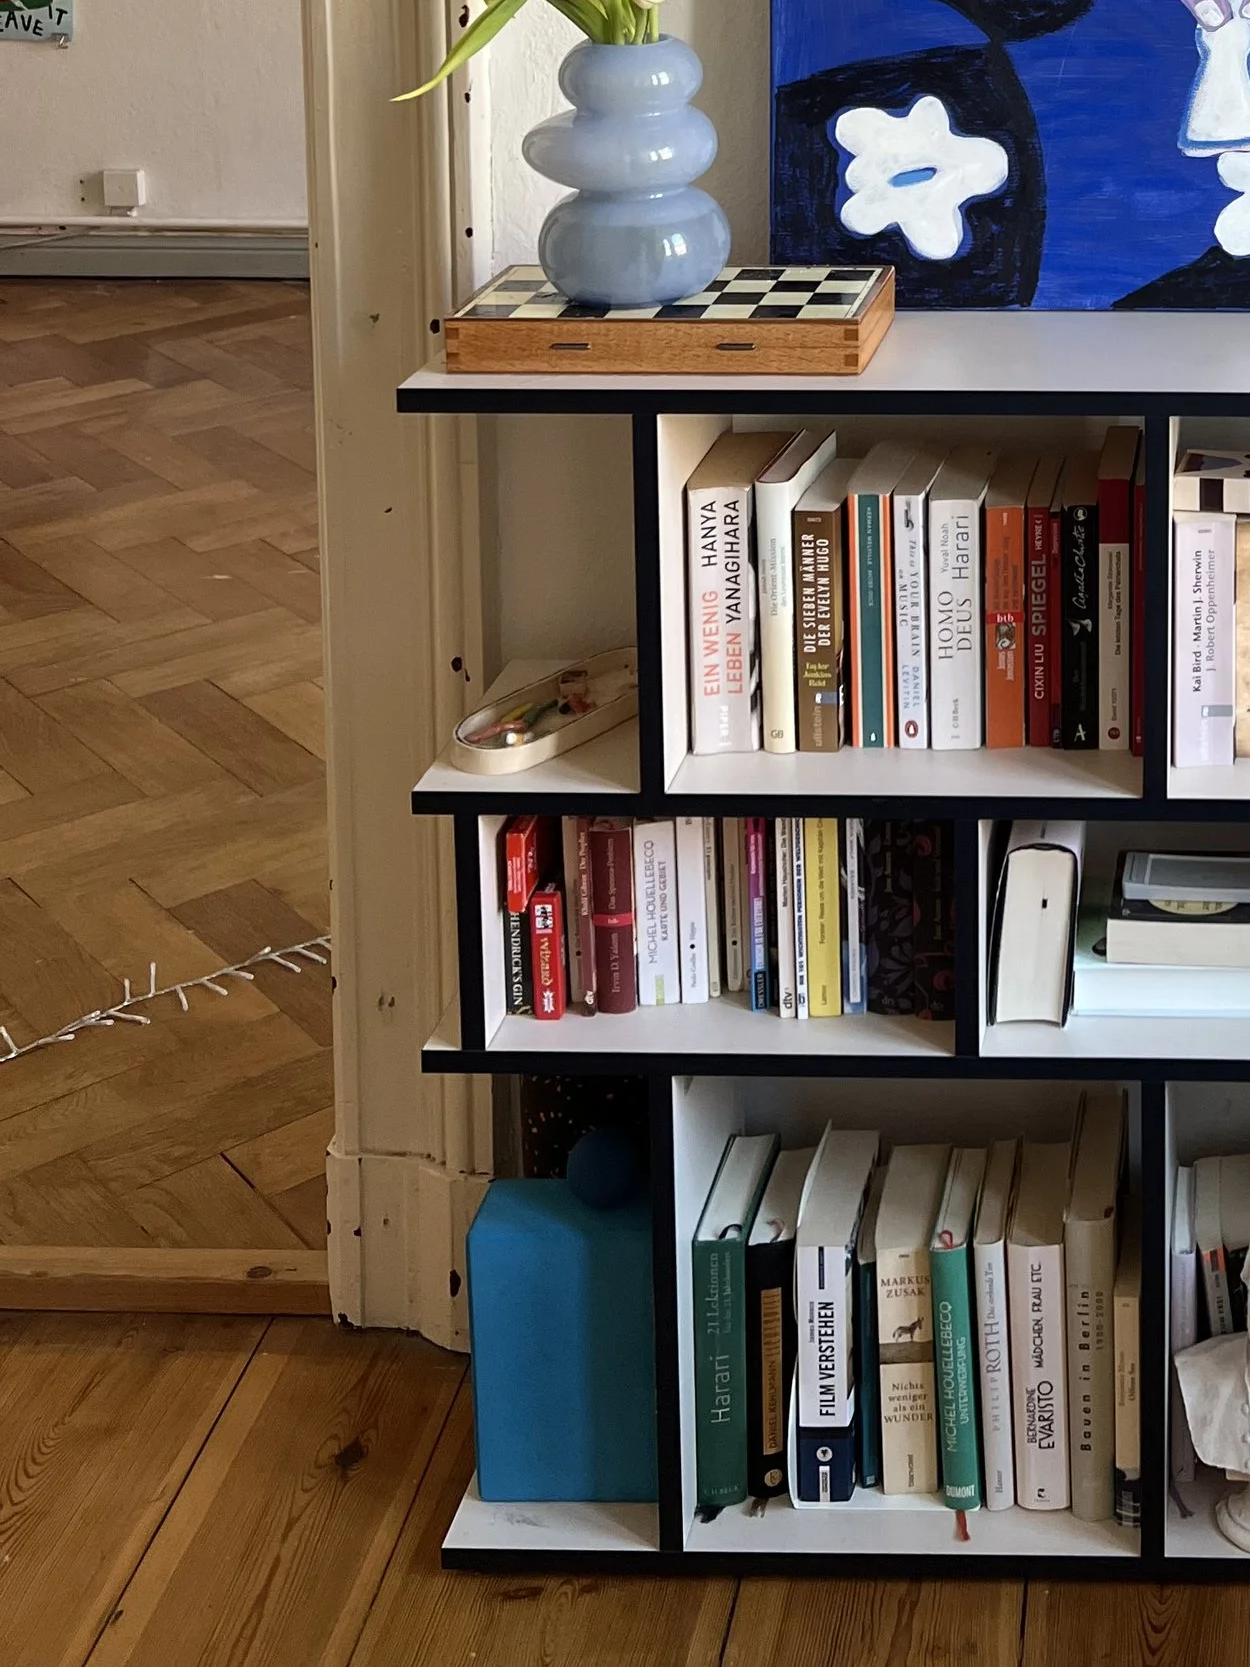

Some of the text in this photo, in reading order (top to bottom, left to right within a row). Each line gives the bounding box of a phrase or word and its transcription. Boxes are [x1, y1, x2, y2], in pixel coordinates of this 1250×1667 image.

[701, 500, 717, 568] HANYA
[723, 499, 741, 624] YANAGIHARA
[951, 515, 969, 579] Harari
[799, 534, 816, 653] DIE SIEBEN MÄNNER
[816, 539, 830, 646] DER EVELYN HUGO
[910, 572, 919, 608] YOUR
[1031, 554, 1047, 636] SPIEGEL
[1192, 551, 1202, 593] Sherwin
[1206, 550, 1217, 623] Oppenheimer
[899, 584, 908, 628] MUSIC
[911, 615, 920, 657] BRAIN
[938, 591, 953, 660] HOMO
[956, 598, 972, 652] DEUS
[996, 614, 1014, 622] btb
[1192, 607, 1202, 641] Martin
[702, 591, 720, 698] EIN WENIG
[726, 633, 743, 695] LEBEN
[1034, 643, 1045, 699] CIXIN LIU
[1192, 651, 1202, 672] Bird
[1206, 626, 1215, 661] Robert
[912, 666, 920, 707] DANIEL
[1193, 674, 1202, 692] Kai
[813, 706, 822, 747] ullstein
[643, 840, 657, 964] MICHEL HOUELLEBECQ
[657, 861, 669, 940] KARTE UND GEBIET
[512, 984, 523, 1006] GIN
[782, 991, 792, 1009] dtv
[707, 1252, 721, 1335] 21 Lektionen
[1032, 1287, 1043, 1312] FRAU
[818, 1301, 835, 1416] FILM VERSTEHEN
[1031, 1316, 1044, 1368] MÄDCHEN,
[1077, 1290, 1092, 1451] Bauen in Berlin
[709, 1354, 732, 1423] Harari
[768, 1360, 778, 1449] DANIEL KEHLMANN
[939, 1301, 958, 1452] MICHEL HOUELLEBECQ
[956, 1337, 970, 1424] UNTERWERFUNG
[983, 1321, 1001, 1432] PHILIP ROTH
[1026, 1387, 1036, 1444] BERNARDINE
[1037, 1380, 1055, 1449] EVARISTO
[945, 1484, 975, 1498] DUMONT
